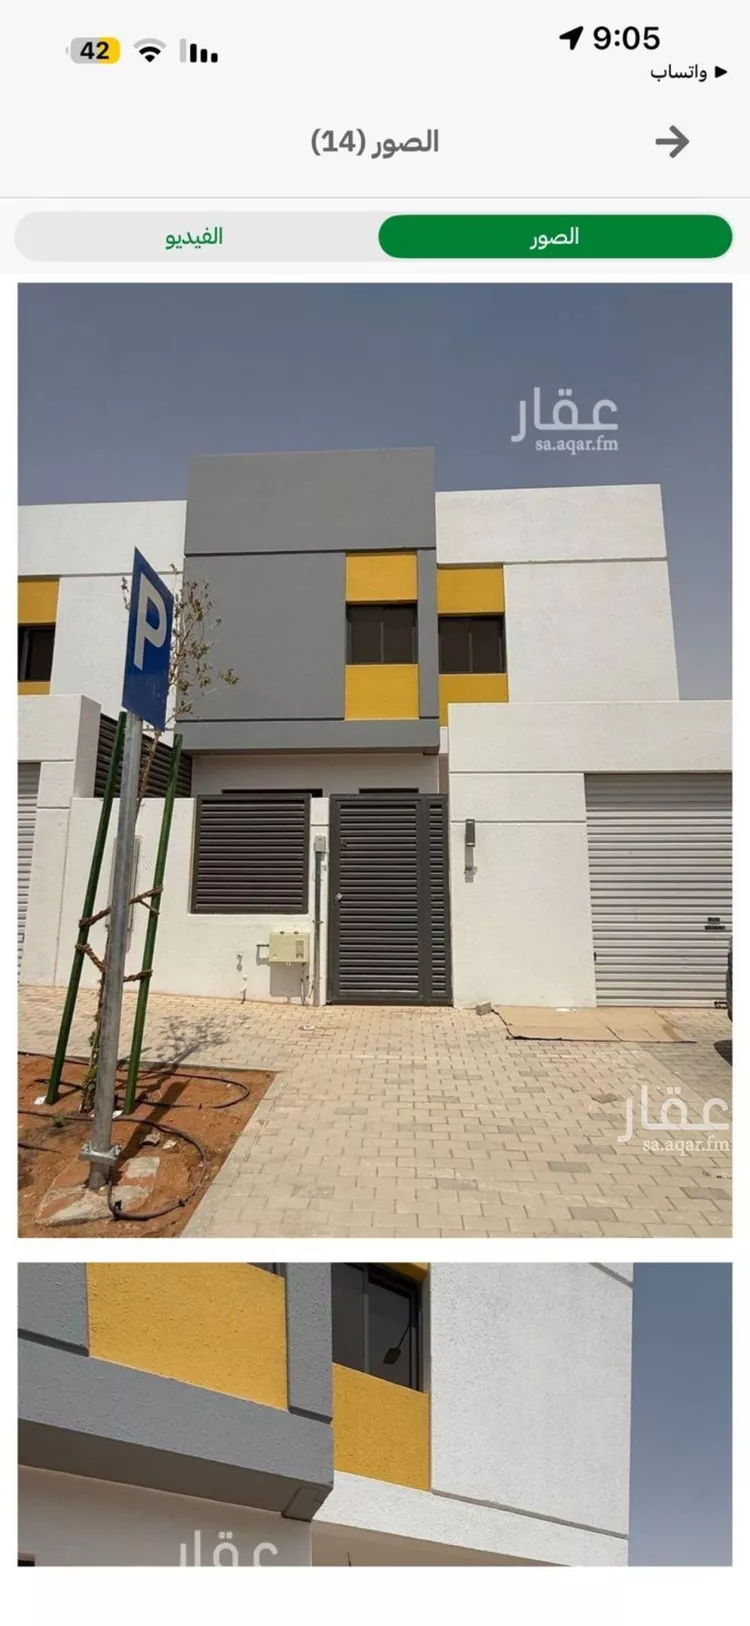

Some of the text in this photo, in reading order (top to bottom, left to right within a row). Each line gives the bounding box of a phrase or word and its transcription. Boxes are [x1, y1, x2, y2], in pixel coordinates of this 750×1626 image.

[80, 41, 110, 60] 42
[593, 25, 660, 51] 9:05
[650, 63, 708, 83] واتساب
[310, 127, 439, 160] الصور (14)
[164, 226, 223, 251] الفيديو
[529, 225, 580, 251] الصور
[133, 571, 168, 671] P
